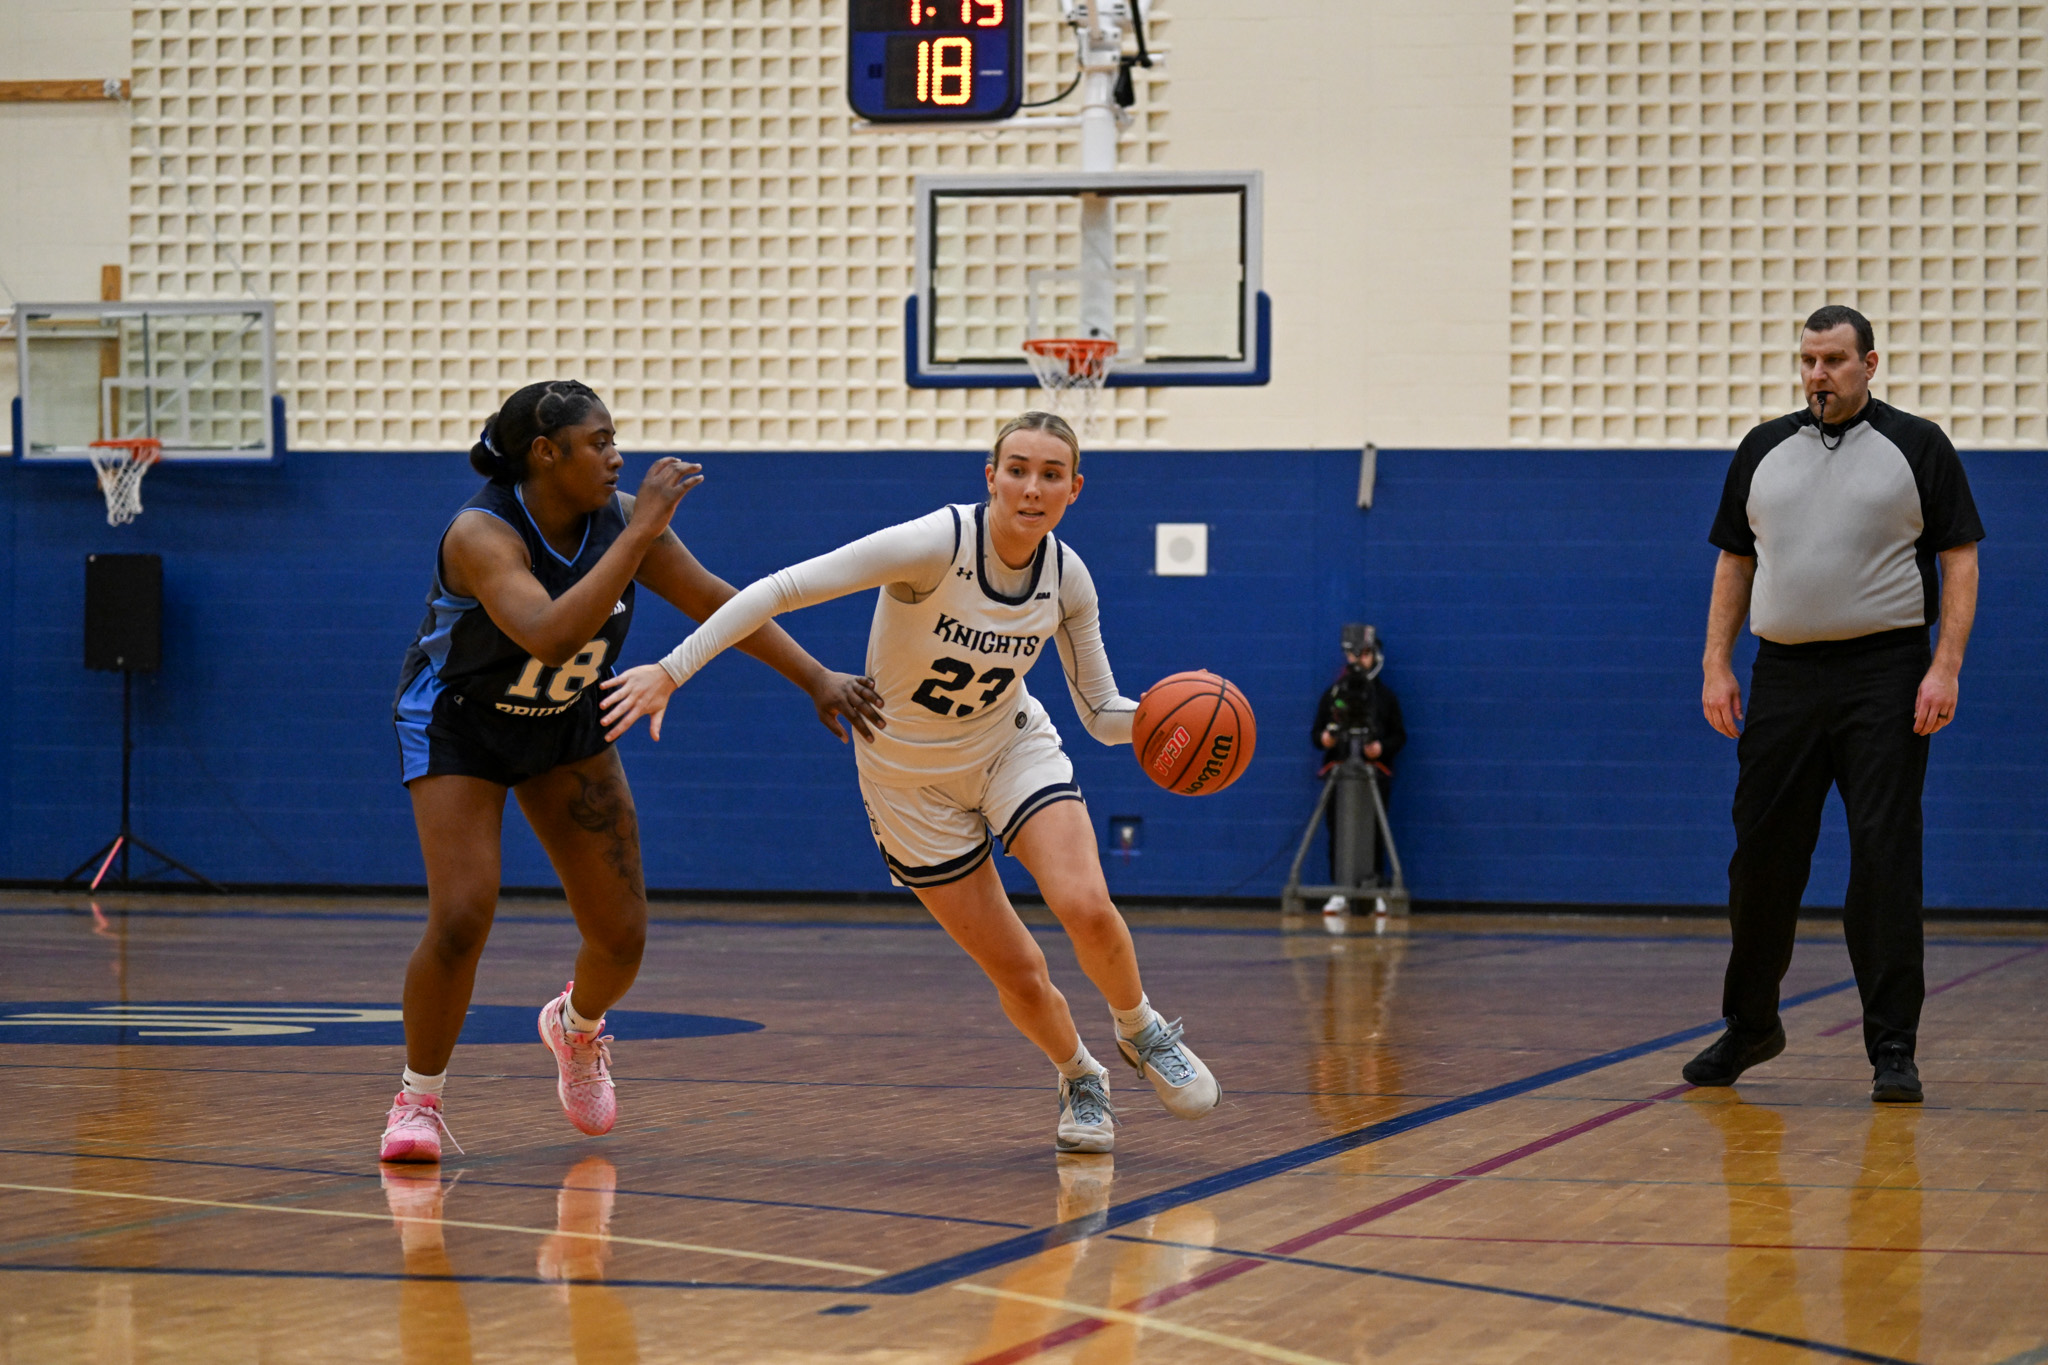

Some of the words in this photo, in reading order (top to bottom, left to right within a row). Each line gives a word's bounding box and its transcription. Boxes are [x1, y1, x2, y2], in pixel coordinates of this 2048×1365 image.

[917, 36, 972, 105] 18
[932, 613, 1040, 658] KNIGHTS
[505, 638, 609, 701] 18
[911, 656, 1016, 717] 23
[1153, 726, 1191, 776] OCAA
[1180, 734, 1234, 794] Wilson
